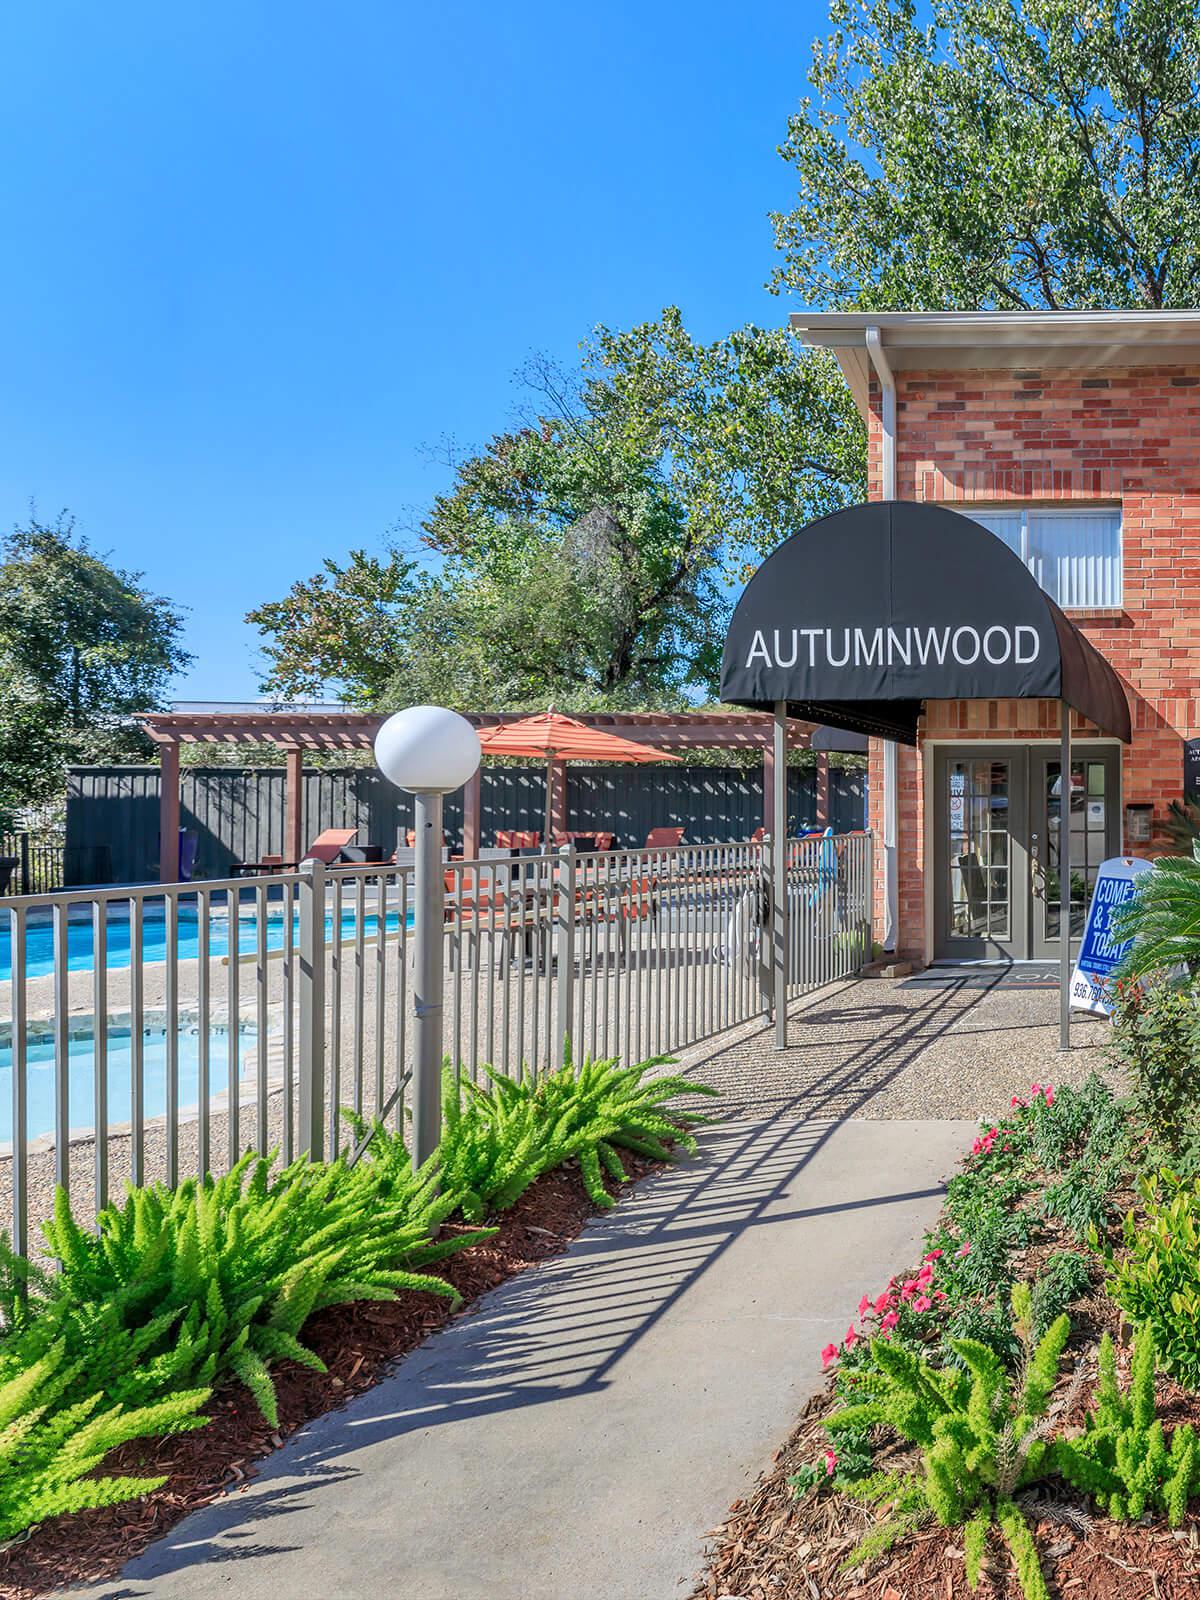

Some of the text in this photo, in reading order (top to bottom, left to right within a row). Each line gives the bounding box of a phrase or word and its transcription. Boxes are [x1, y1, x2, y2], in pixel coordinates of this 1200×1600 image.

[745, 625, 1041, 669] AUTUMNWOOD
[1097, 880, 1132, 905] COME
[1090, 932, 1127, 959] TODAY
